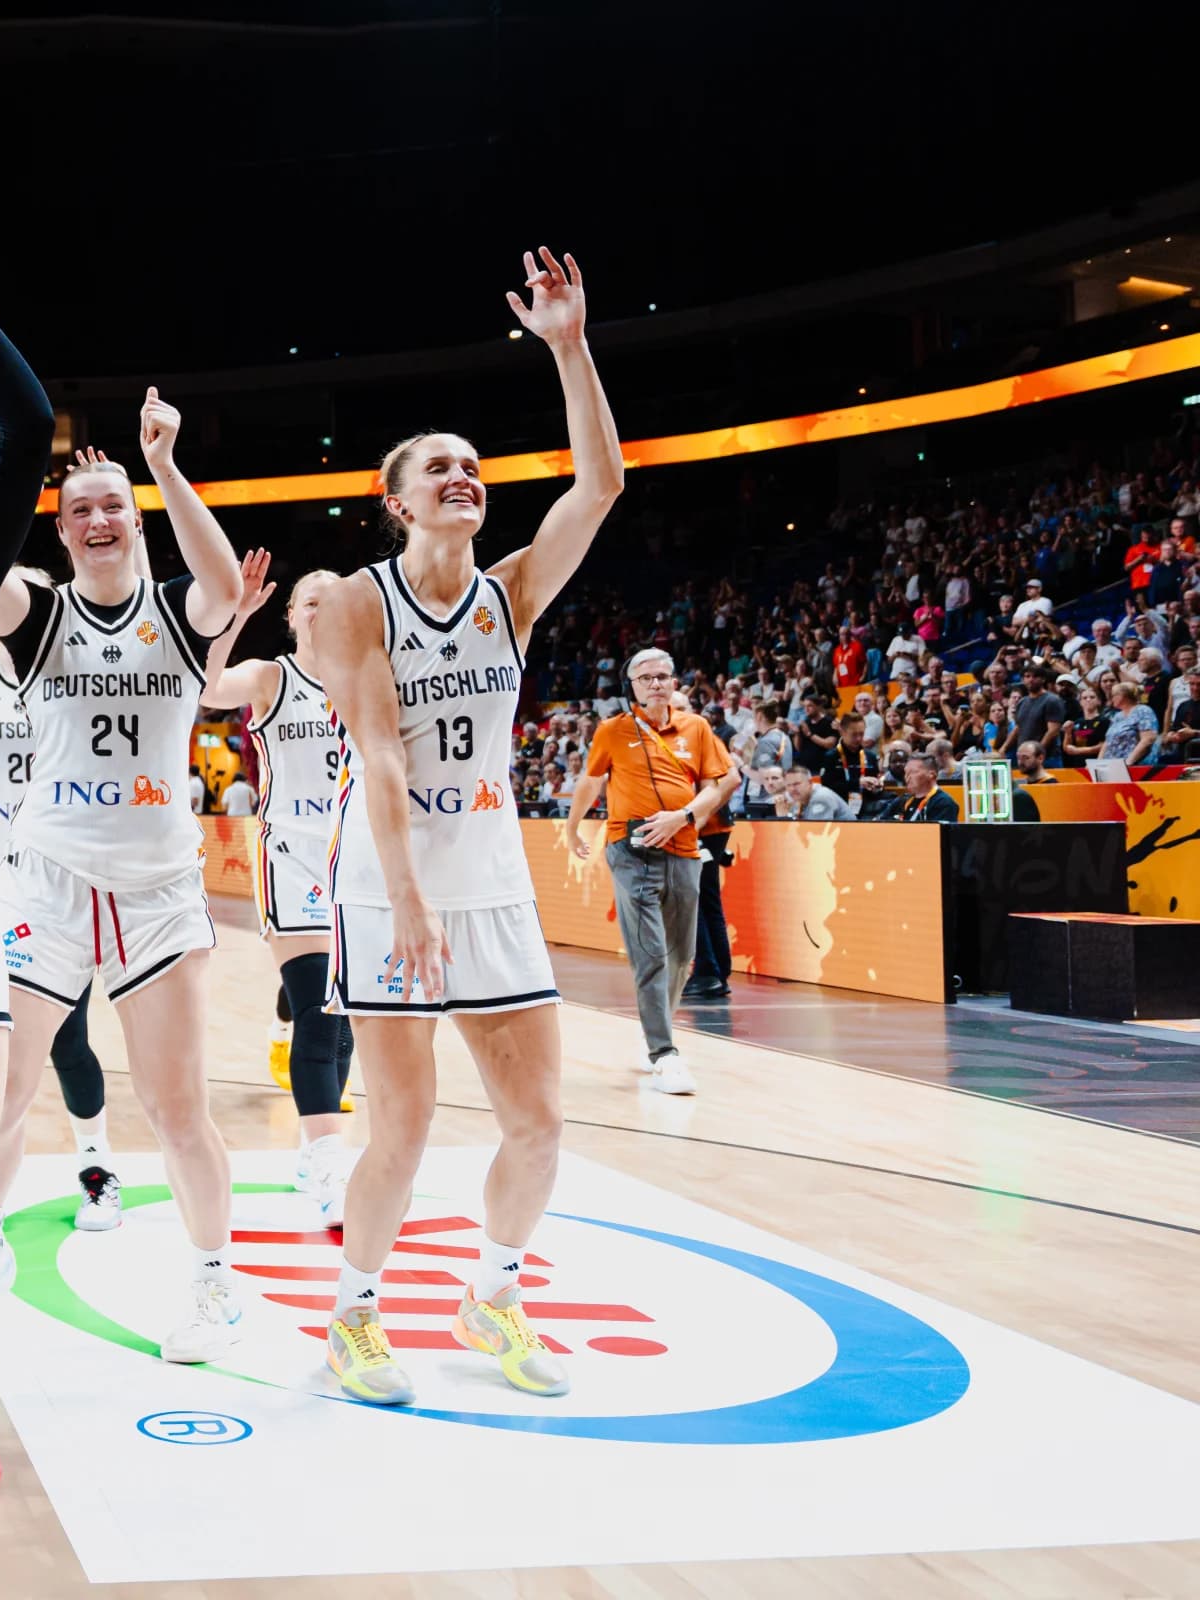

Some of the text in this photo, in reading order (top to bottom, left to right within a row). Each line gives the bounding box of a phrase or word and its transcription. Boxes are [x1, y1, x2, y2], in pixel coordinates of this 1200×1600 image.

[43, 673, 182, 702] DEUTSCHLAND
[396, 666, 517, 707] UTSCHLAND
[91, 714, 139, 757] 24
[278, 721, 335, 742] DEUTSC
[435, 715, 473, 761] 13
[325, 750, 339, 781] 9
[52, 781, 123, 806] ING
[407, 787, 464, 814] NG
